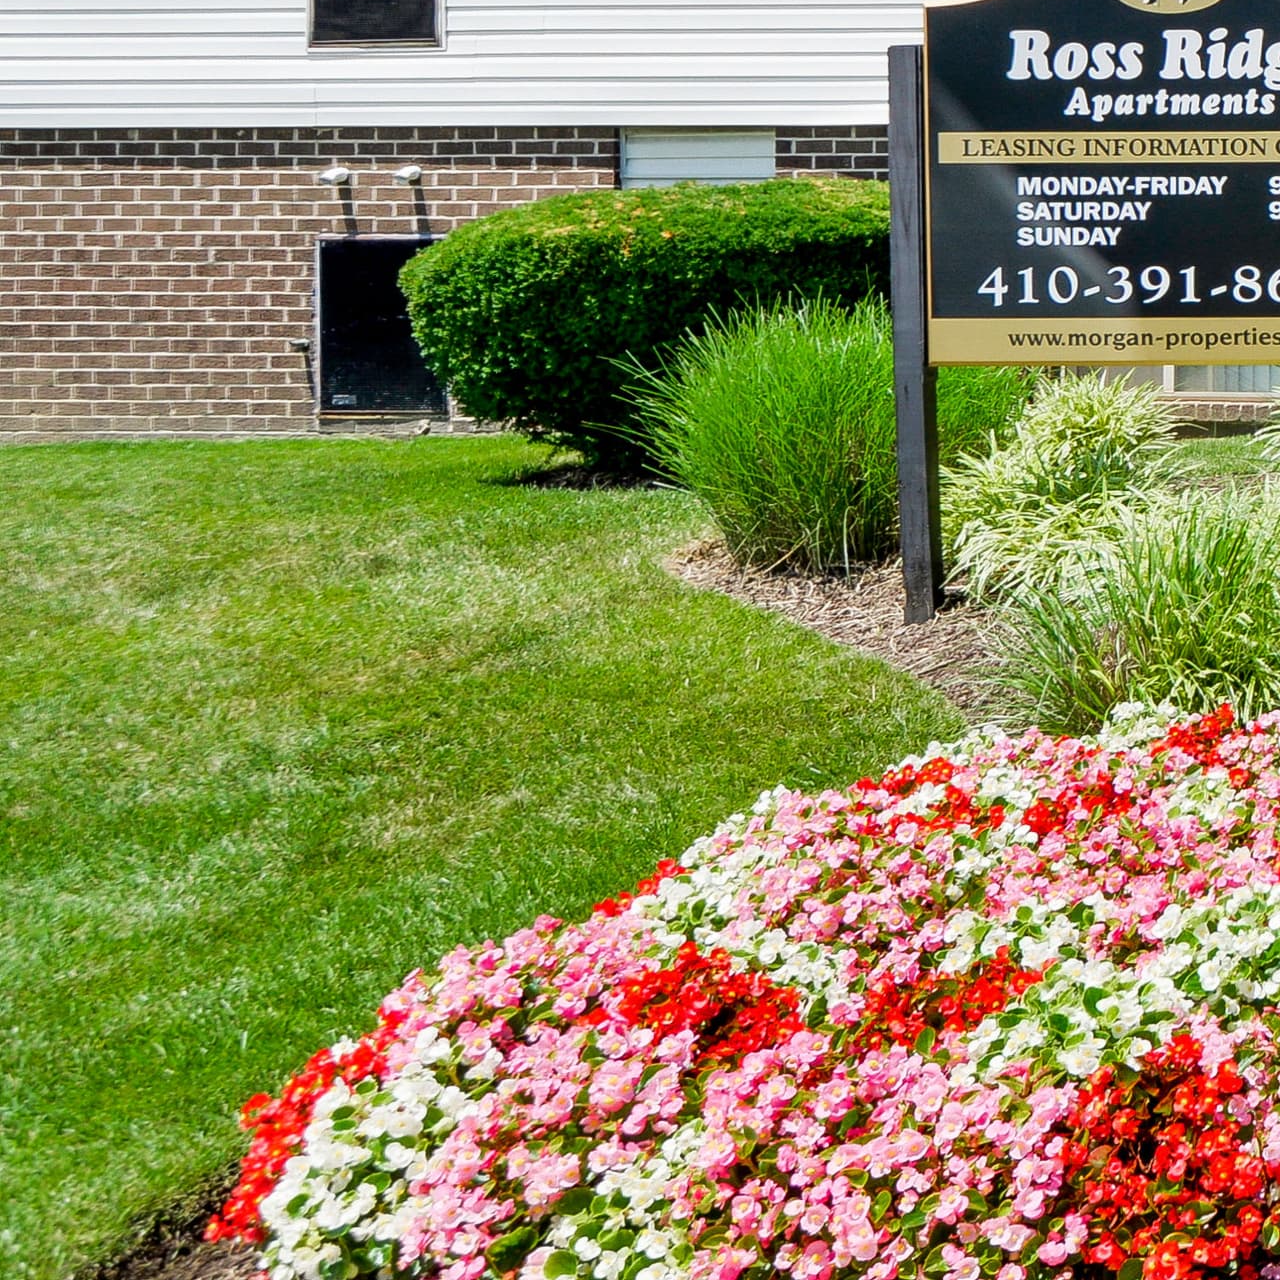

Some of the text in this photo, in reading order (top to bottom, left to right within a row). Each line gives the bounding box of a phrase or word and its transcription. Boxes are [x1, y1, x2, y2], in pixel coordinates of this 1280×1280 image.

[1006, 29, 1144, 80] Ross
[1063, 86, 1276, 122] Apartments
[962, 138, 1076, 157] LEASING
[1083, 138, 1268, 157] INFORMATION
[1016, 176, 1228, 196] MONDAY-FRIDAY
[1016, 201, 1152, 221] SATURDAY
[1016, 226, 1122, 246] SUNDAY
